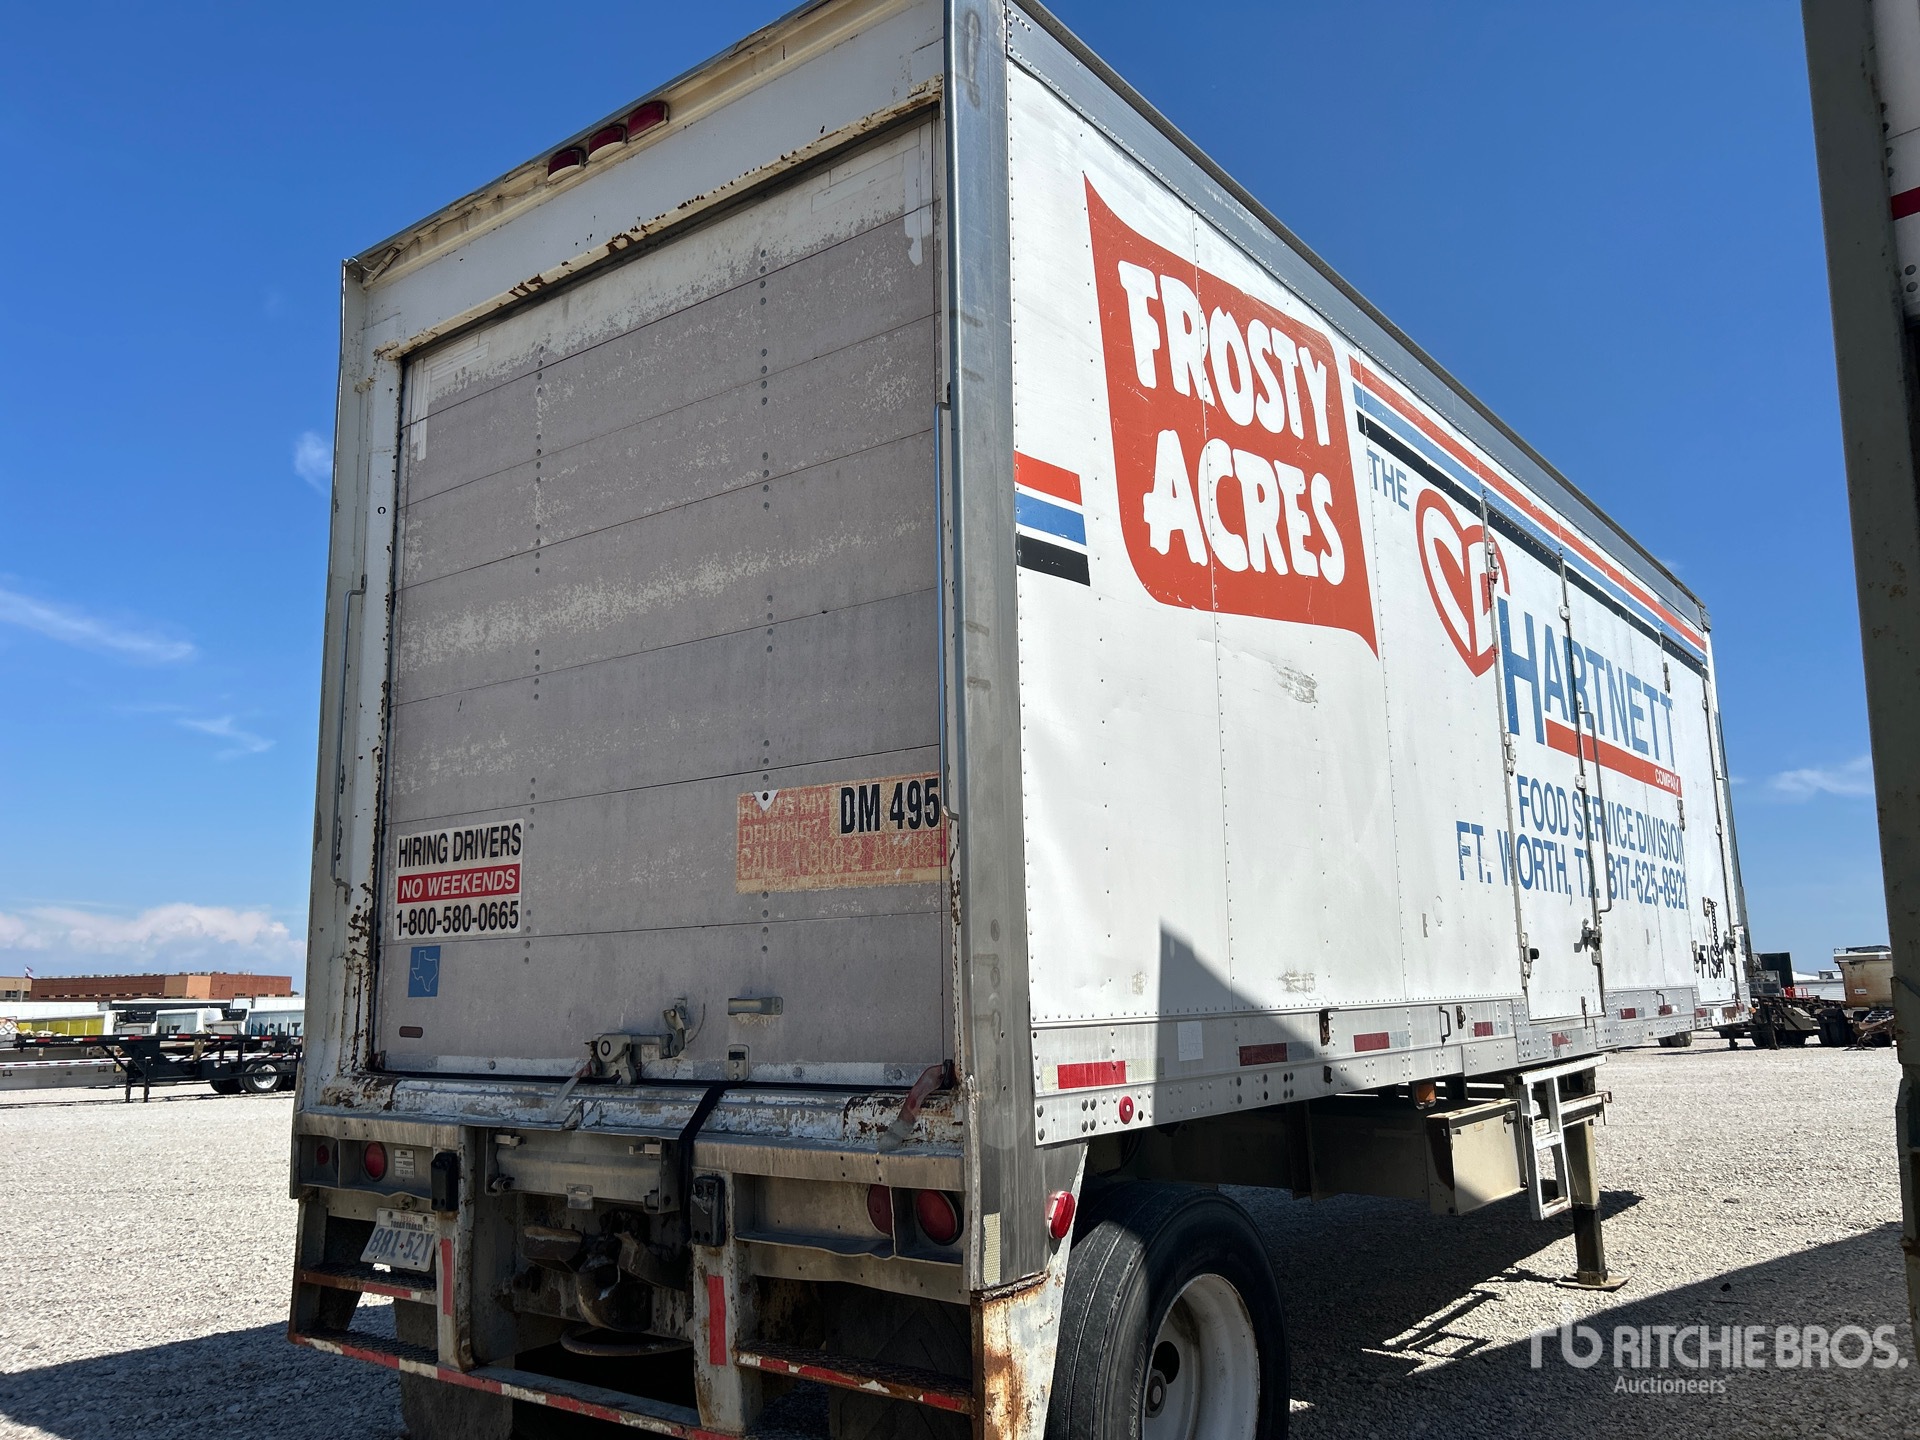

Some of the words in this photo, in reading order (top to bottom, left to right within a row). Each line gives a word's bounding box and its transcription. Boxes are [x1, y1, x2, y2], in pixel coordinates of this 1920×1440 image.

[1118, 260, 1330, 447] FROSTY
[1143, 430, 1345, 585] ACRES
[1367, 448, 1409, 511] THE
[1497, 596, 1674, 767] HARTNETT
[841, 784, 880, 834] DM
[889, 777, 940, 830] 495
[1517, 774, 1569, 836] FOOD
[1573, 790, 1636, 851] SERVICE
[1636, 810, 1684, 865] DIVISION
[398, 833, 448, 868] HIRING
[453, 823, 521, 862] DRIVERS
[1456, 820, 1491, 884] FT.
[1497, 829, 1572, 906] WORTH,
[396, 900, 519, 936] 1-800-580-0665
[401, 878, 423, 899] NO
[427, 868, 516, 897] WEEKENDS
